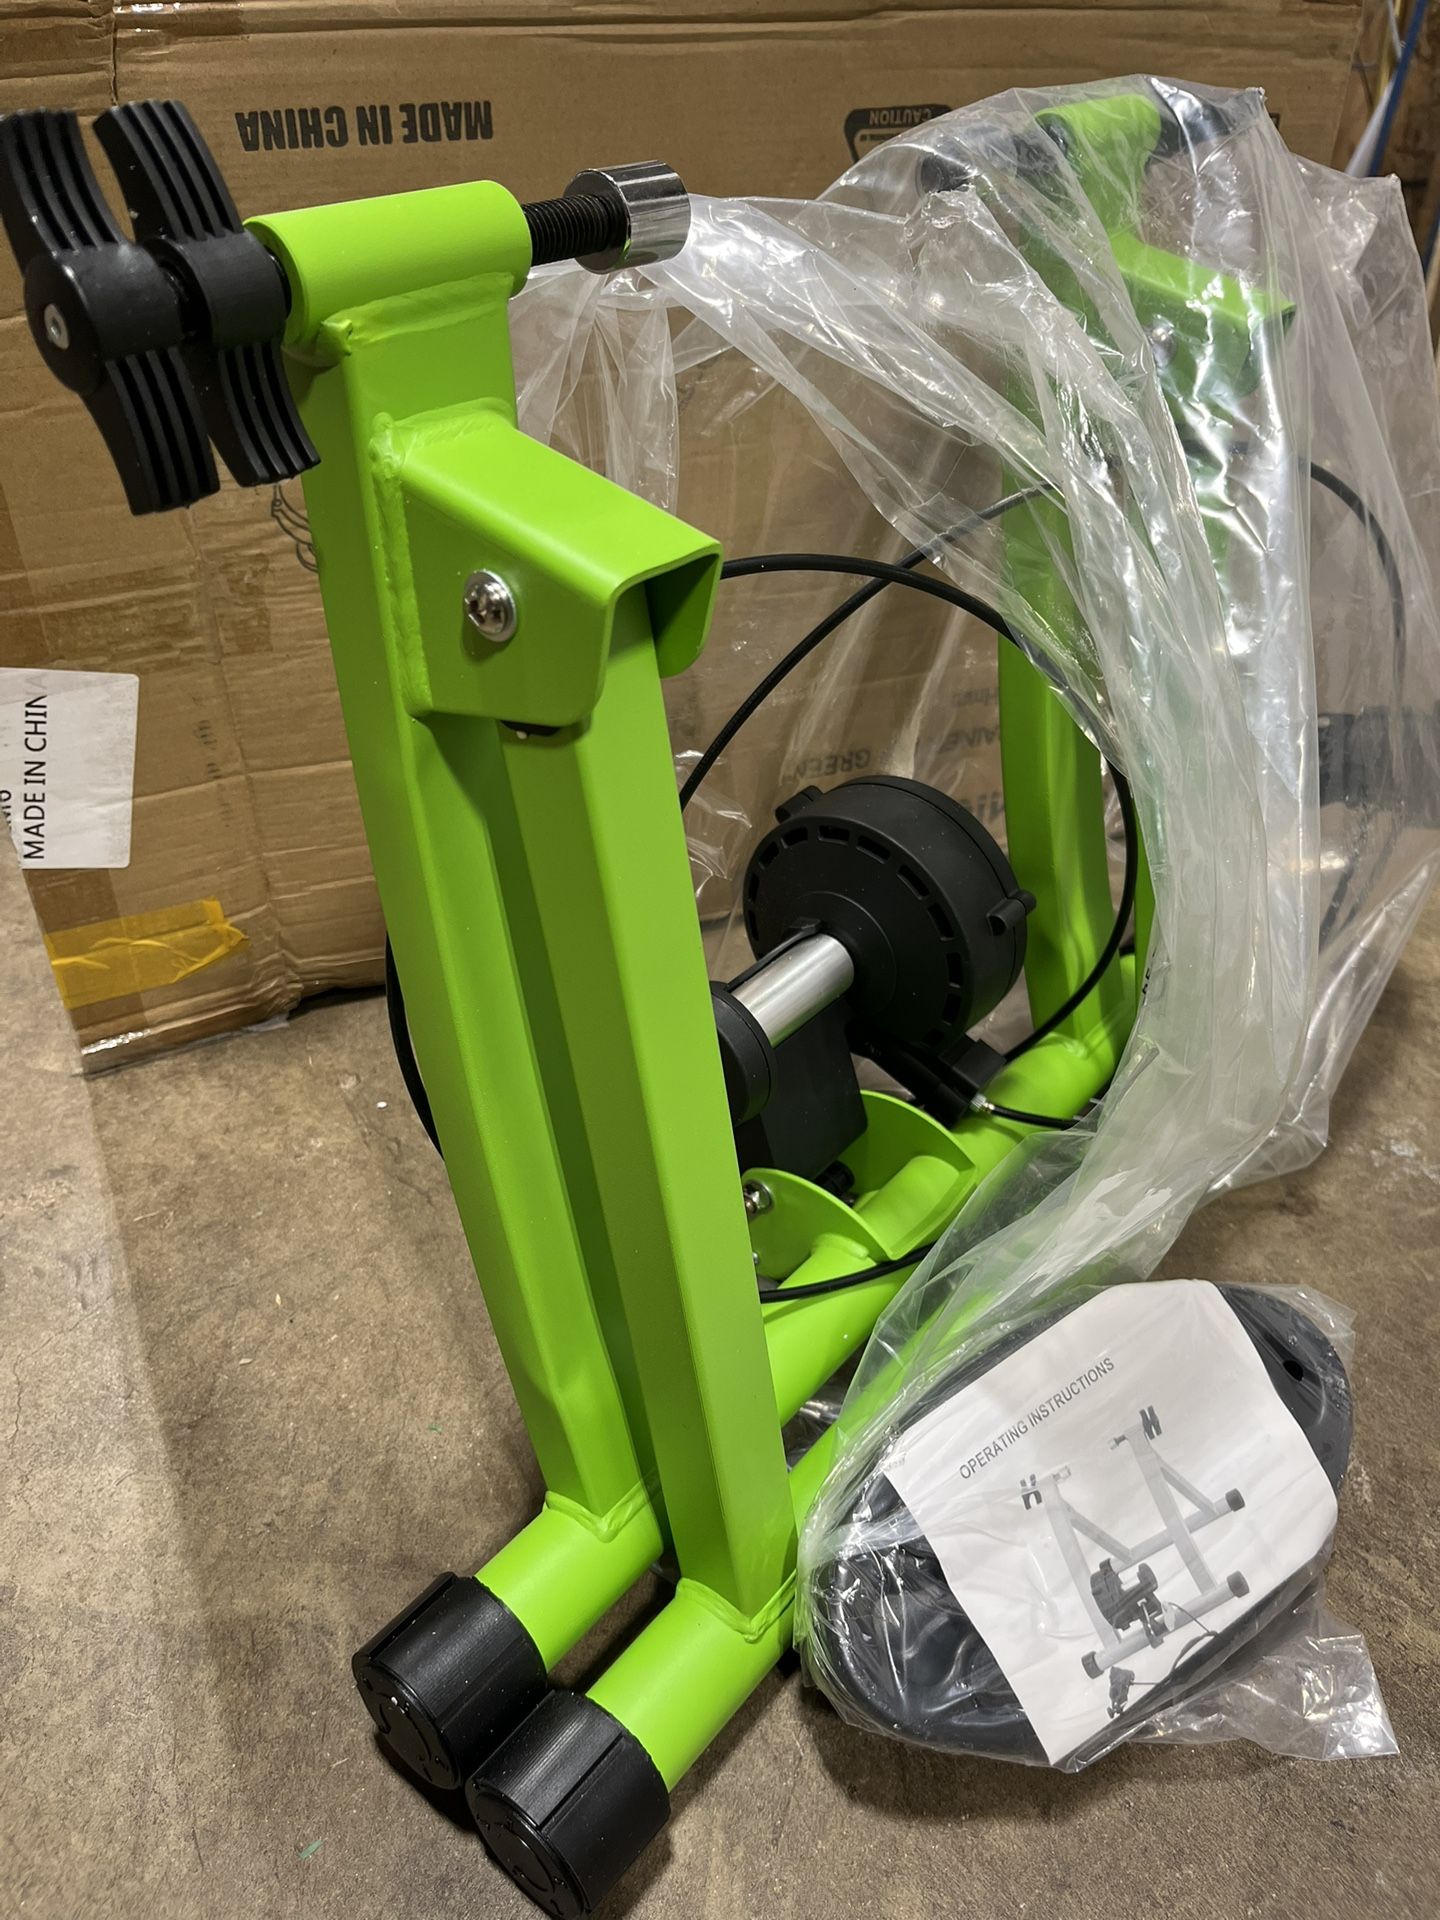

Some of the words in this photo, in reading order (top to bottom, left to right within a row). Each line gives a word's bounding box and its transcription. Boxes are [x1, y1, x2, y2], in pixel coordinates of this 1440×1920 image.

[234, 106, 349, 153] CHINA
[355, 105, 393, 146] IN
[400, 101, 493, 143] MADE
[869, 108, 933, 125] CAUTION
[24, 761, 47, 785] IN
[24, 792, 46, 859] MADE
[958, 1420, 1030, 1480] OPERATING
[1028, 1357, 1116, 1427] INSTRUCTIONS
